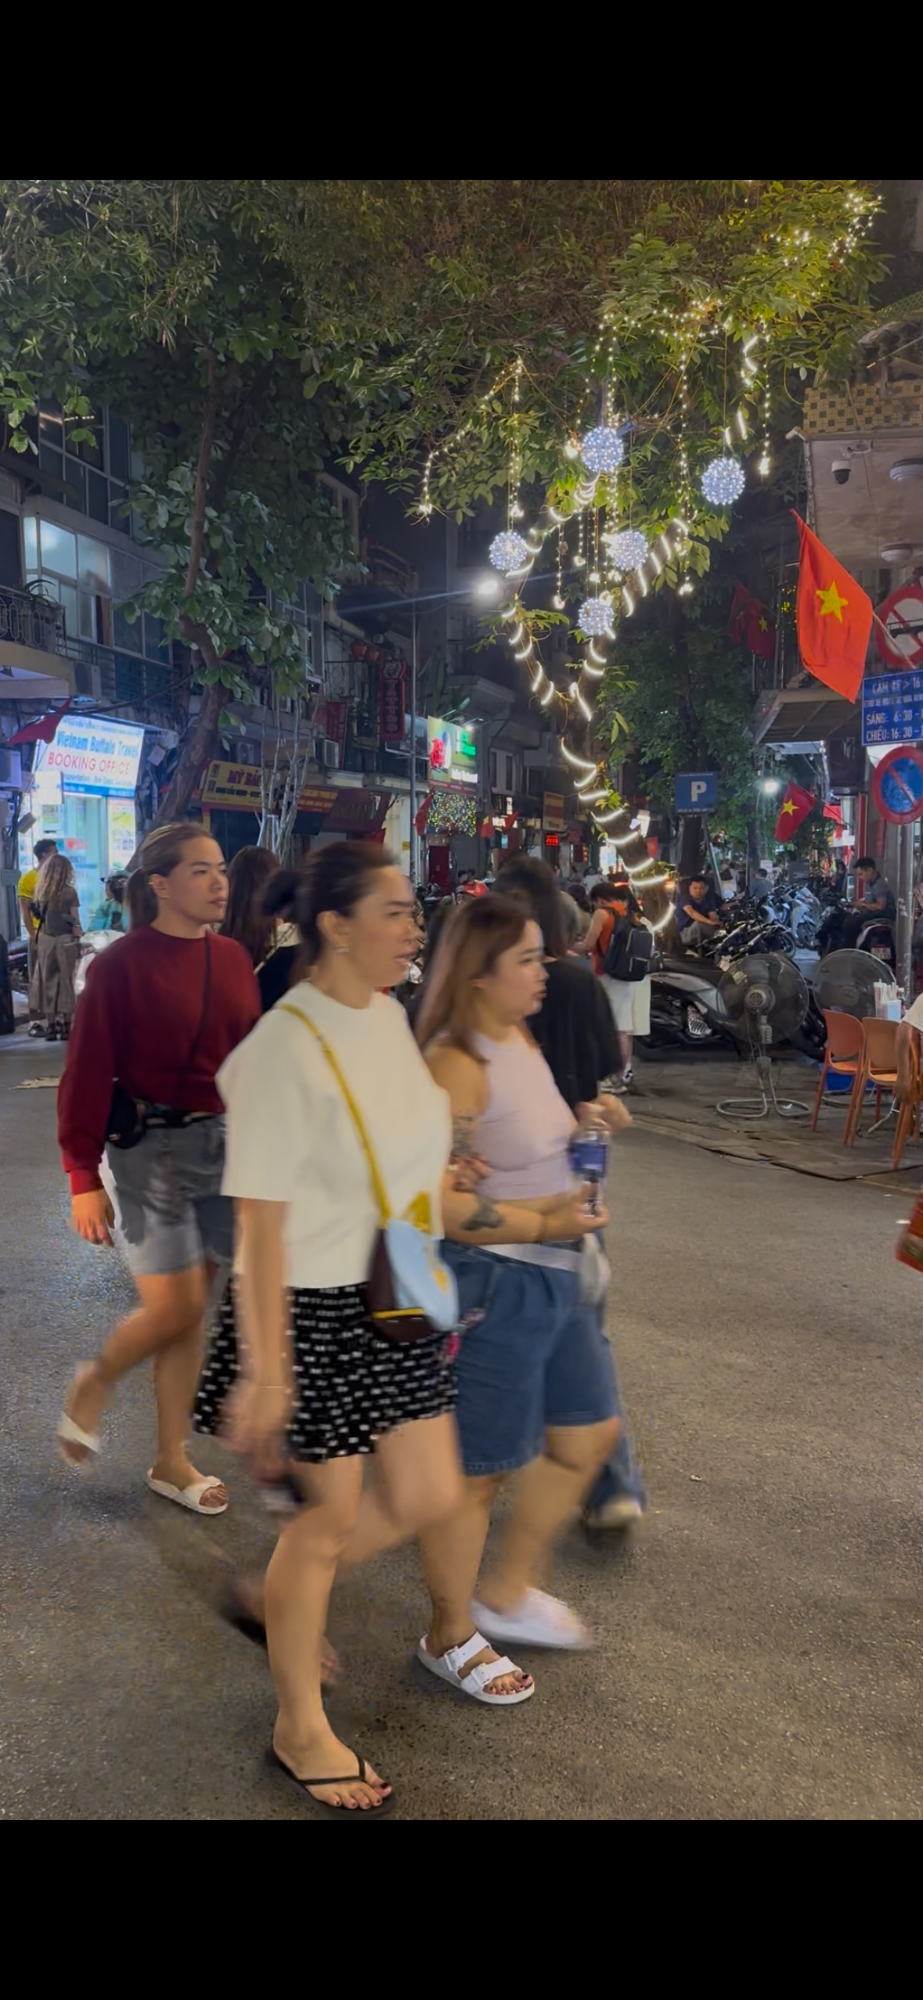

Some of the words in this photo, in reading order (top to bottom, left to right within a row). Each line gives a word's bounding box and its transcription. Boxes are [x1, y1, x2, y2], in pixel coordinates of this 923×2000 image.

[56, 729, 89, 751] Vietnam
[89, 735, 116, 755] Buffalo
[117, 740, 139, 758] Travel
[47, 751, 97, 771] BOOKING
[99, 759, 130, 775] OFFICE
[691, 781, 707, 802] P
